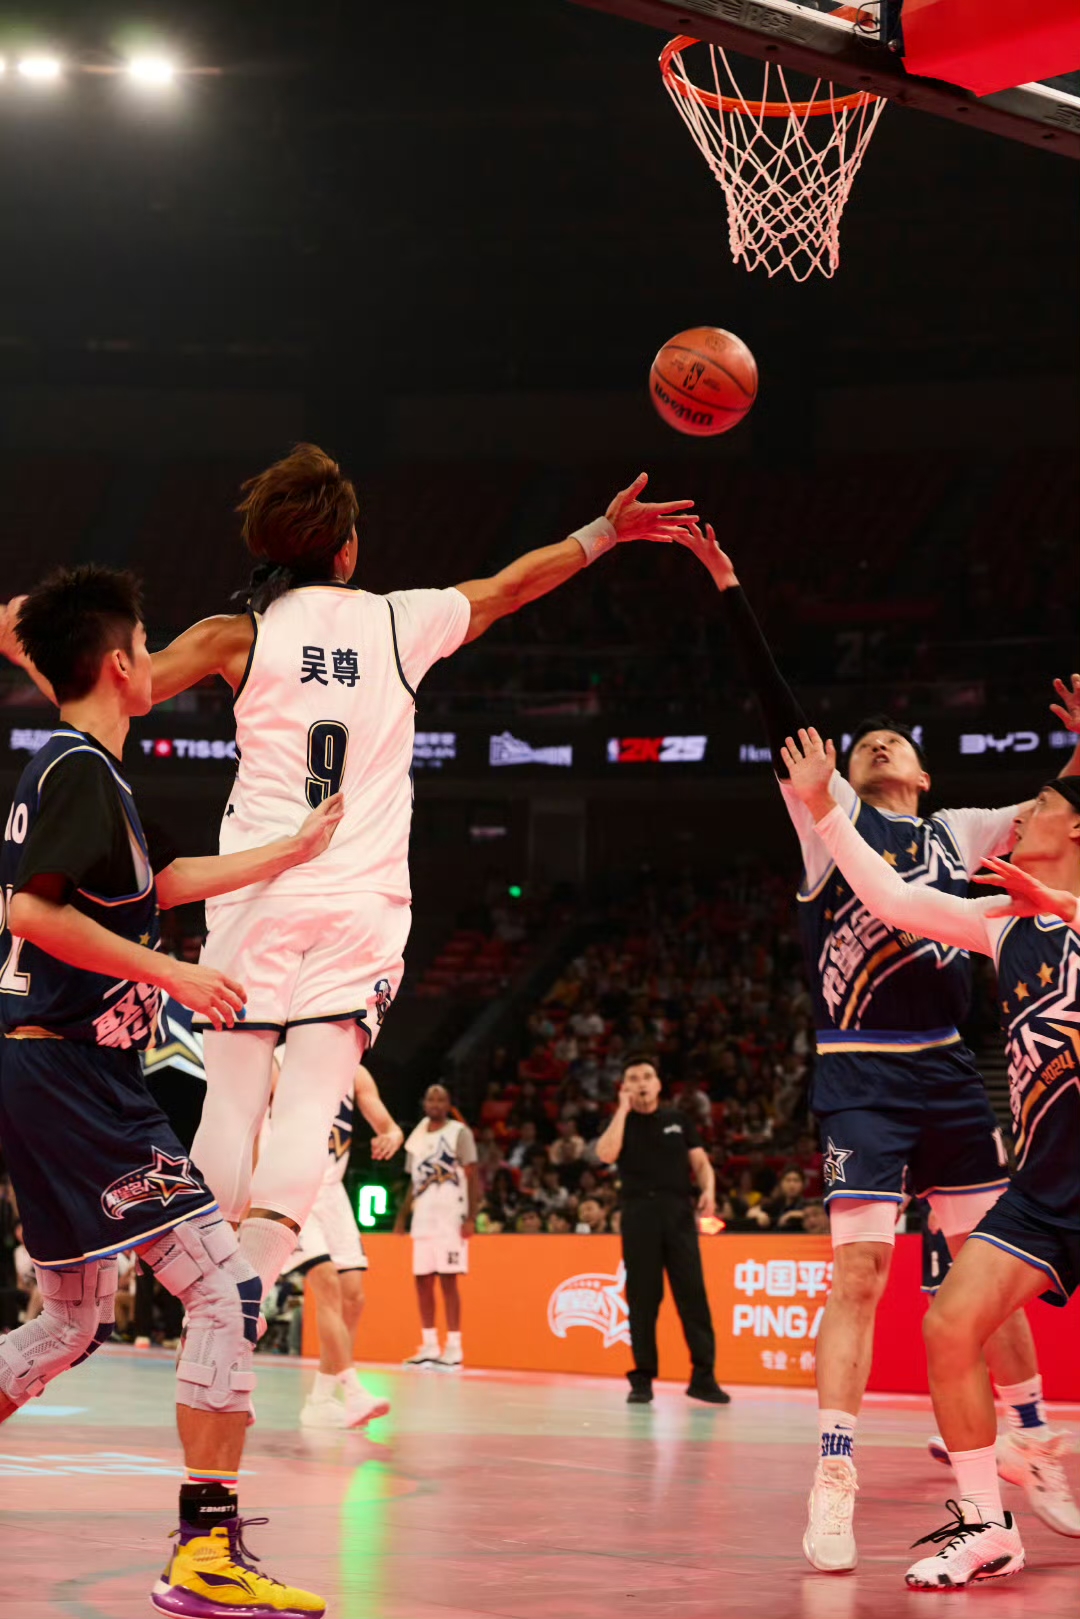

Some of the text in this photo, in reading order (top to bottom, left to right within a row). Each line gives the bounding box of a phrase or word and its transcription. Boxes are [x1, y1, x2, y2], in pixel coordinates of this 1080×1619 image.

[300, 646, 361, 688] 吴尊
[959, 730, 1040, 755] BYD
[304, 719, 349, 812] 9
[1041, 1049, 1077, 1086] 2024
